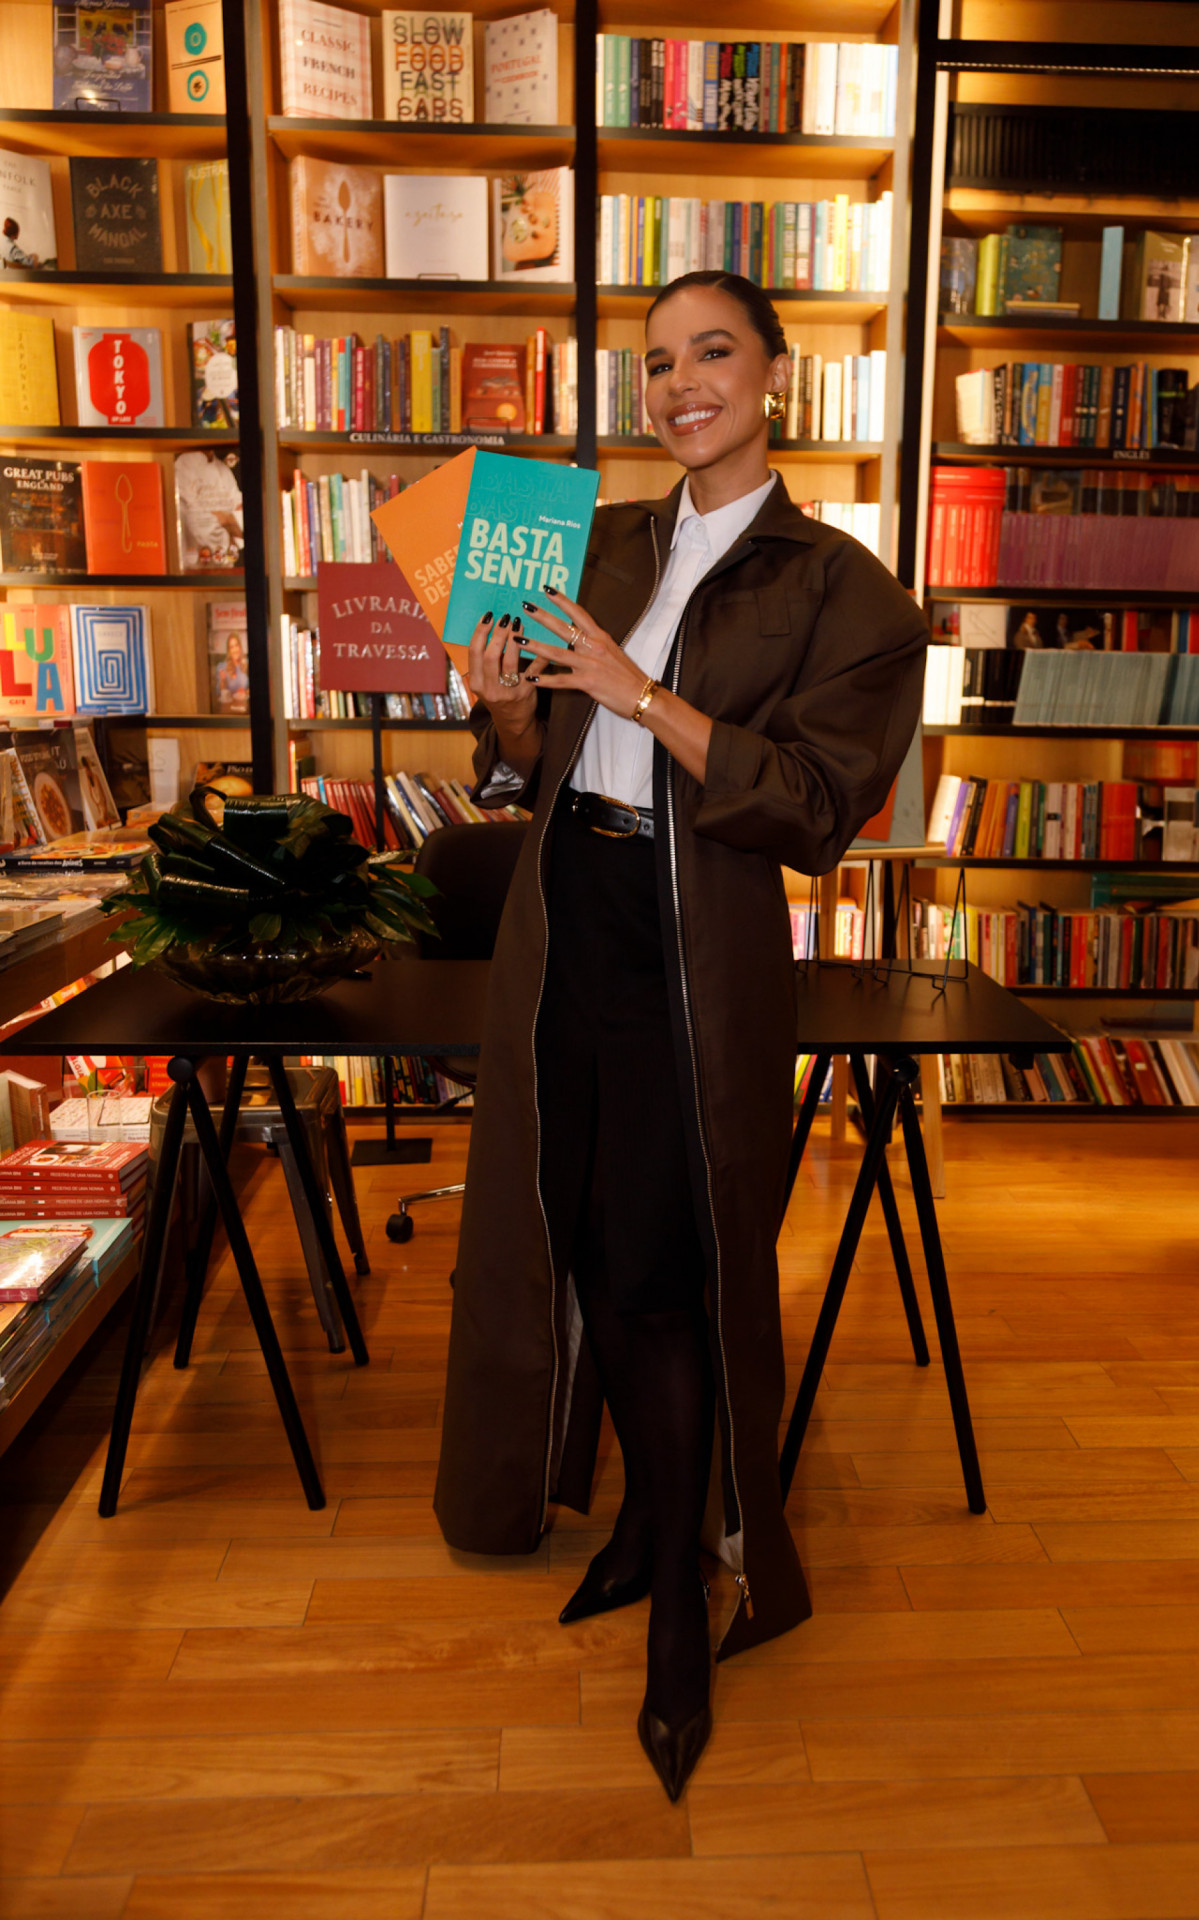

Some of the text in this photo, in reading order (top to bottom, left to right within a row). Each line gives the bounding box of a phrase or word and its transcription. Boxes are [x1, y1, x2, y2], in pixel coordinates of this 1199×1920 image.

[301, 29, 356, 54] CLASSIC
[393, 16, 465, 45] SLOW
[303, 56, 355, 79] FRENCH
[394, 43, 464, 72] FOOD
[303, 82, 357, 106] RECIPES
[400, 71, 460, 98] FAST
[86, 174, 143, 198] BLACK
[101, 203, 132, 219] AXE
[313, 210, 374, 231] BAKERY
[88, 222, 147, 248] MANGAL
[113, 340, 127, 415] TOKYO
[350, 433, 505, 446] CULINÁRIA E GASTRONOMIA
[3, 466, 74, 483] GREAT PUBS
[16, 479, 65, 491] ENGLAND
[538, 515, 581, 529] Mariana Rios
[469, 517, 564, 564] BASTA
[464, 549, 569, 594] SENTIR
[423, 578, 450, 605] DE
[371, 621, 392, 634] DA
[333, 643, 430, 660] TRAVESSA
